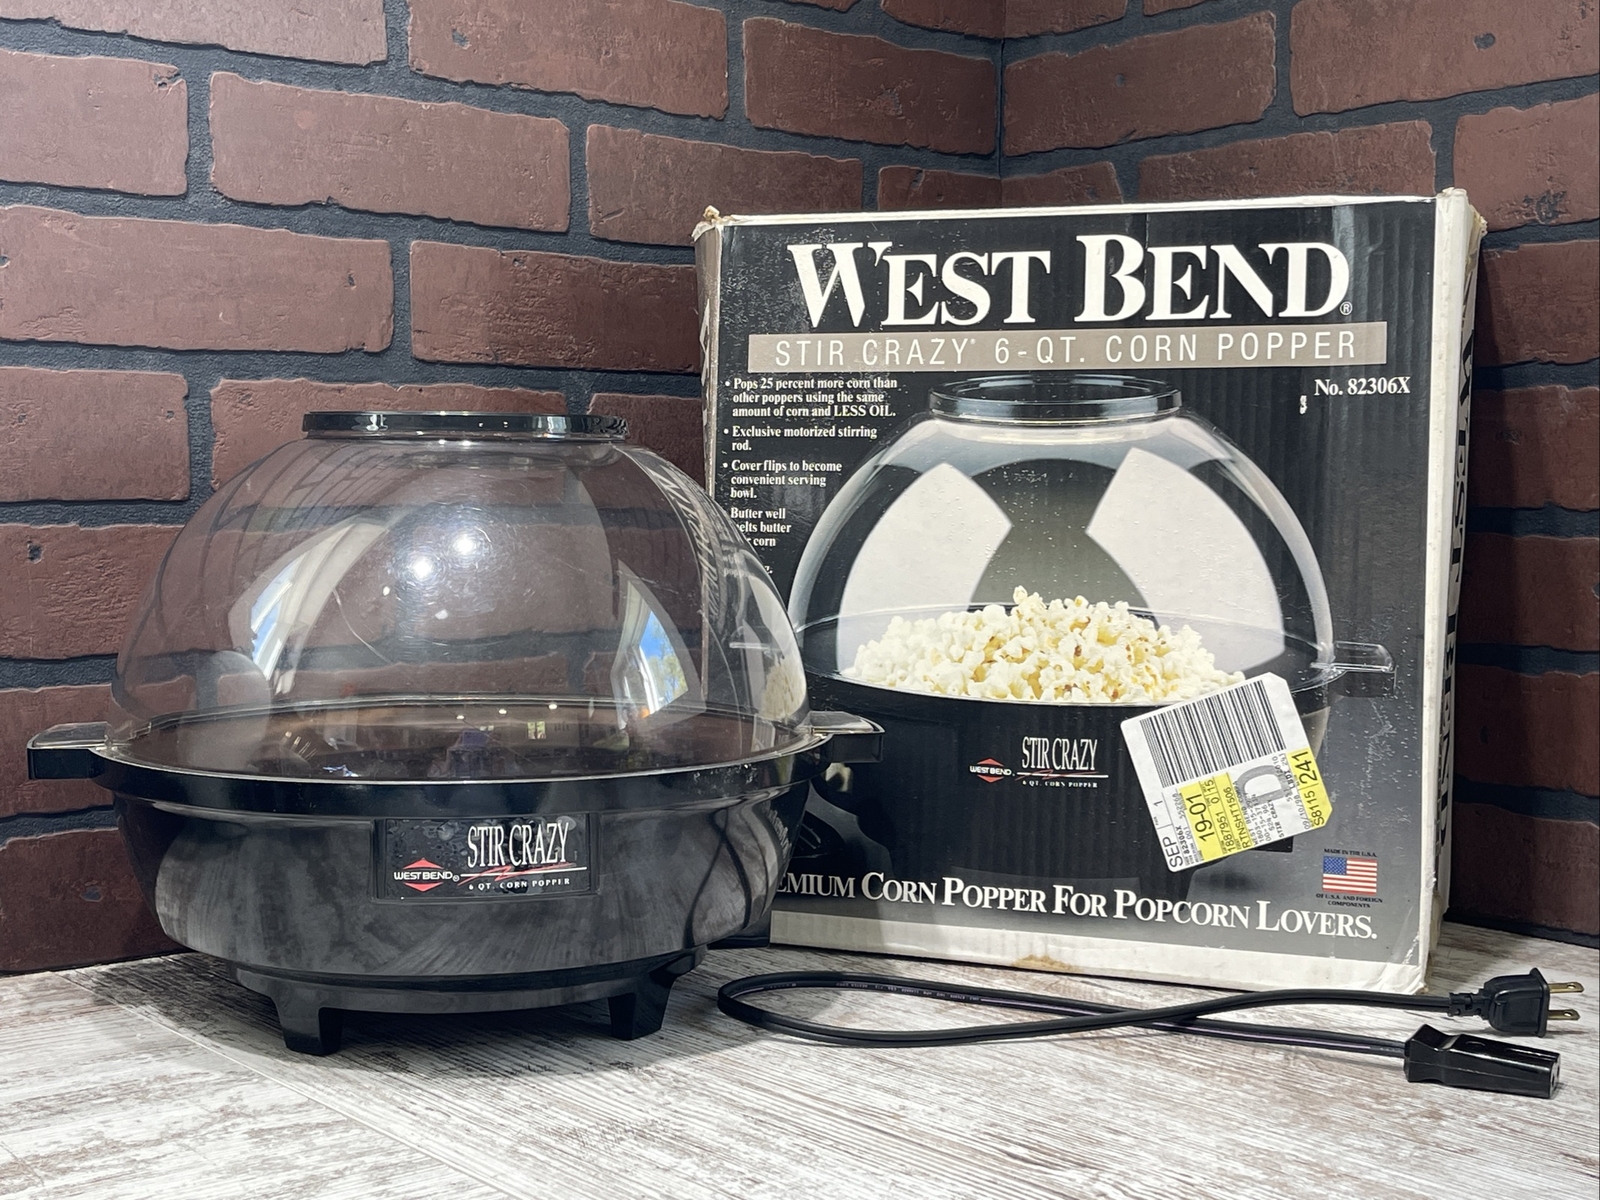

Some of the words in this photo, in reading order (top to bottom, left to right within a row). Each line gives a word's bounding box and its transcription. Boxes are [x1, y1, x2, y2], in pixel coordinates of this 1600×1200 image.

[786, 240, 1052, 328] WEST
[775, 339, 844, 366] STIR
[994, 336, 1086, 365] 6-QT.
[1105, 334, 1197, 363] CORN
[1217, 330, 1356, 361] POPPER
[733, 377, 758, 391] Pops
[760, 378, 773, 389] 25
[775, 378, 815, 390] percent
[817, 379, 847, 389] more
[847, 379, 871, 389] corn
[873, 377, 898, 389] than
[1315, 378, 1344, 397] No.
[1347, 376, 1411, 395] 82306X
[732, 392, 759, 403] other
[762, 394, 803, 405] poppers
[805, 392, 834, 405] using
[836, 392, 854, 402] the
[856, 394, 885, 402] same
[732, 406, 771, 417] amount
[773, 405, 785, 417] of
[786, 407, 809, 416] corn
[811, 405, 831, 416] and
[833, 405, 867, 417] LESS
[869, 405, 897, 417] OIL.
[732, 426, 782, 437] Exclusive
[784, 425, 836, 437] motorized
[838, 425, 878, 439] stirring
[731, 440, 752, 451] rod.
[731, 460, 762, 471] Cover
[763, 459, 787, 473] flips
[789, 461, 800, 471] to
[802, 460, 843, 472] become
[730, 474, 786, 485] convenient
[787, 475, 827, 487] serving
[730, 487, 757, 499] bowl.
[730, 507, 763, 519] Butter
[765, 508, 786, 519] well
[759, 521, 792, 533] butter
[753, 537, 777, 547] corn
[1022, 736, 1050, 769] STIR
[1052, 737, 1098, 771] CRAZY
[1291, 751, 1318, 784] 241
[1203, 779, 1216, 793] 15
[1210, 796, 1221, 805] 0
[1303, 790, 1325, 827] S8115
[1185, 793, 1215, 842] 19-01
[1222, 785, 1251, 849] RTNSHT1506
[1215, 810, 1237, 853] 1887951
[467, 825, 506, 869] STIR
[508, 822, 570, 866] CRAZY
[1162, 836, 1184, 868] SEP
[393, 871, 422, 881] WEST
[499, 881, 528, 889] CORN
[531, 877, 571, 887] POPPER
[861, 871, 937, 905] CORN
[942, 876, 1047, 913] POPPER
[1052, 884, 1108, 918] FOR
[1112, 889, 1251, 929] POPCORN
[1256, 900, 1378, 940] LOVERS.
[1327, 900, 1371, 908] COMPONENTS
